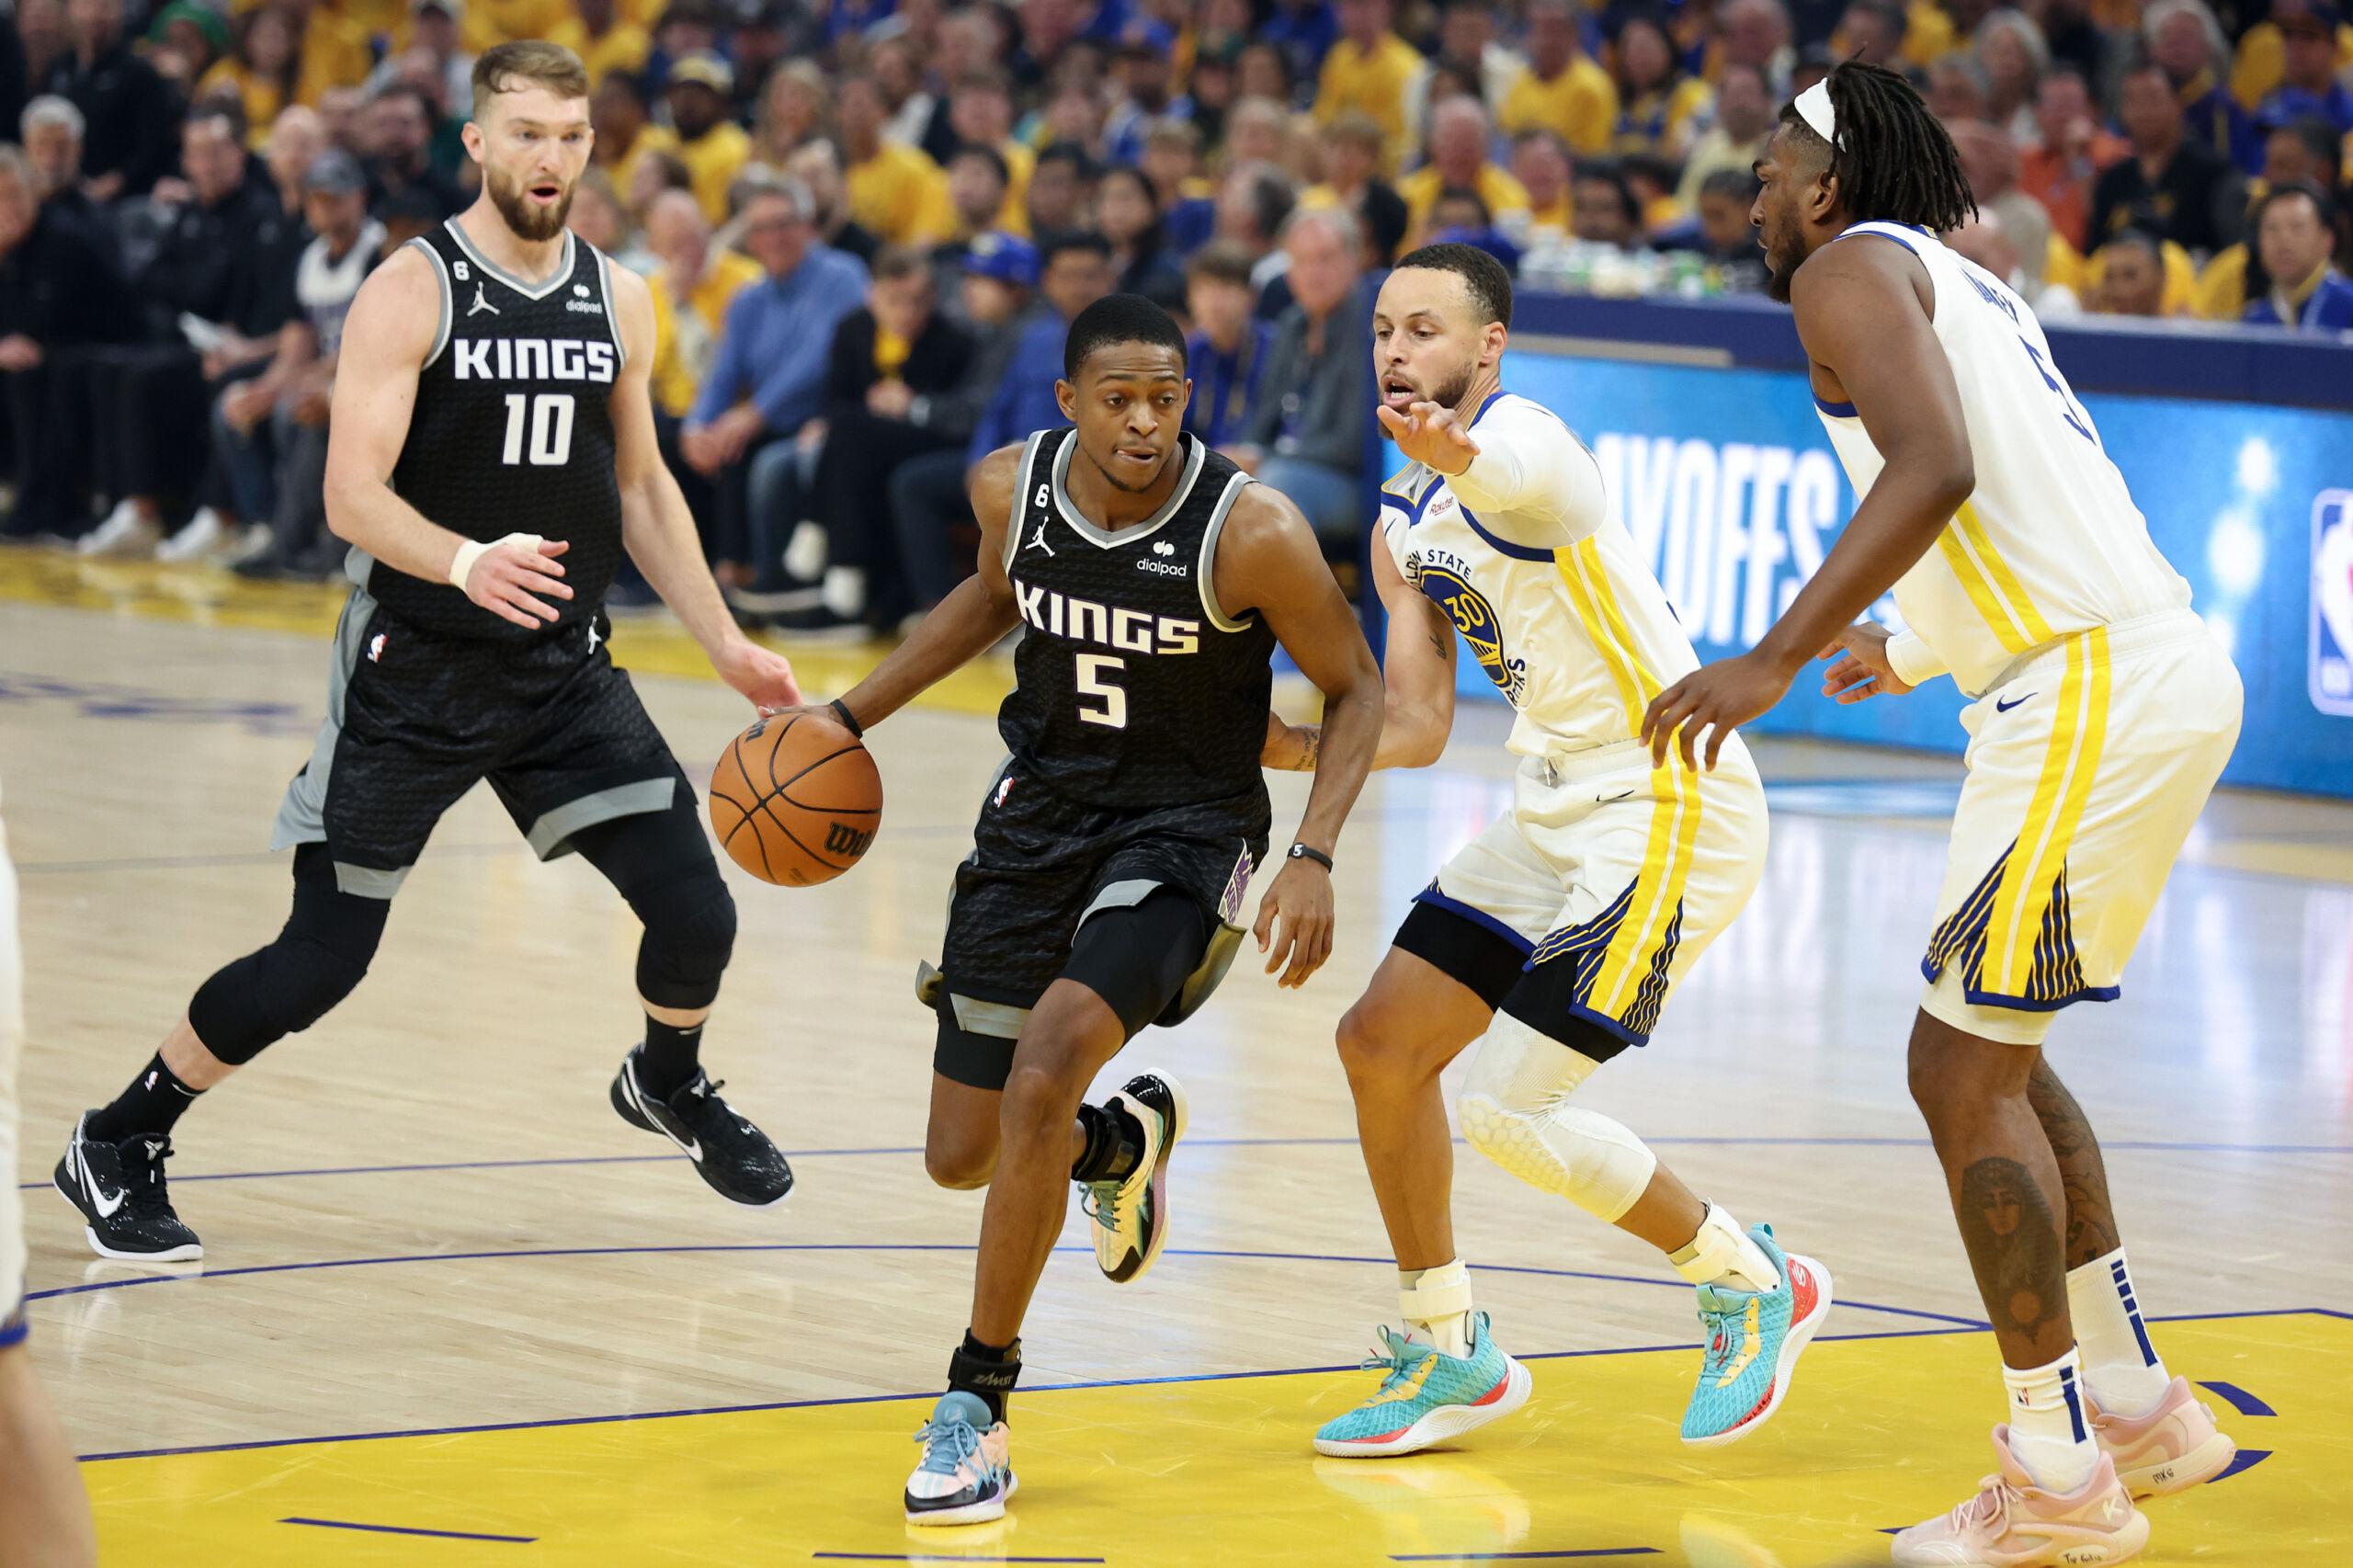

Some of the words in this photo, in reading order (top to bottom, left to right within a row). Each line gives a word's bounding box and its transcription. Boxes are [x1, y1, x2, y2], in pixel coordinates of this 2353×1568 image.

[453, 261, 470, 281] 6
[565, 300, 603, 314] dialpad
[454, 338, 614, 383] KINGS
[2018, 334, 2097, 446] 5
[502, 393, 575, 465] 10
[1034, 483, 1051, 508] 6
[1136, 558, 1188, 576] dialpad
[1427, 549, 1472, 581] STATE
[1013, 578, 1200, 655] KINGS
[1443, 593, 1485, 633] 30
[1074, 652, 1128, 730] 5
